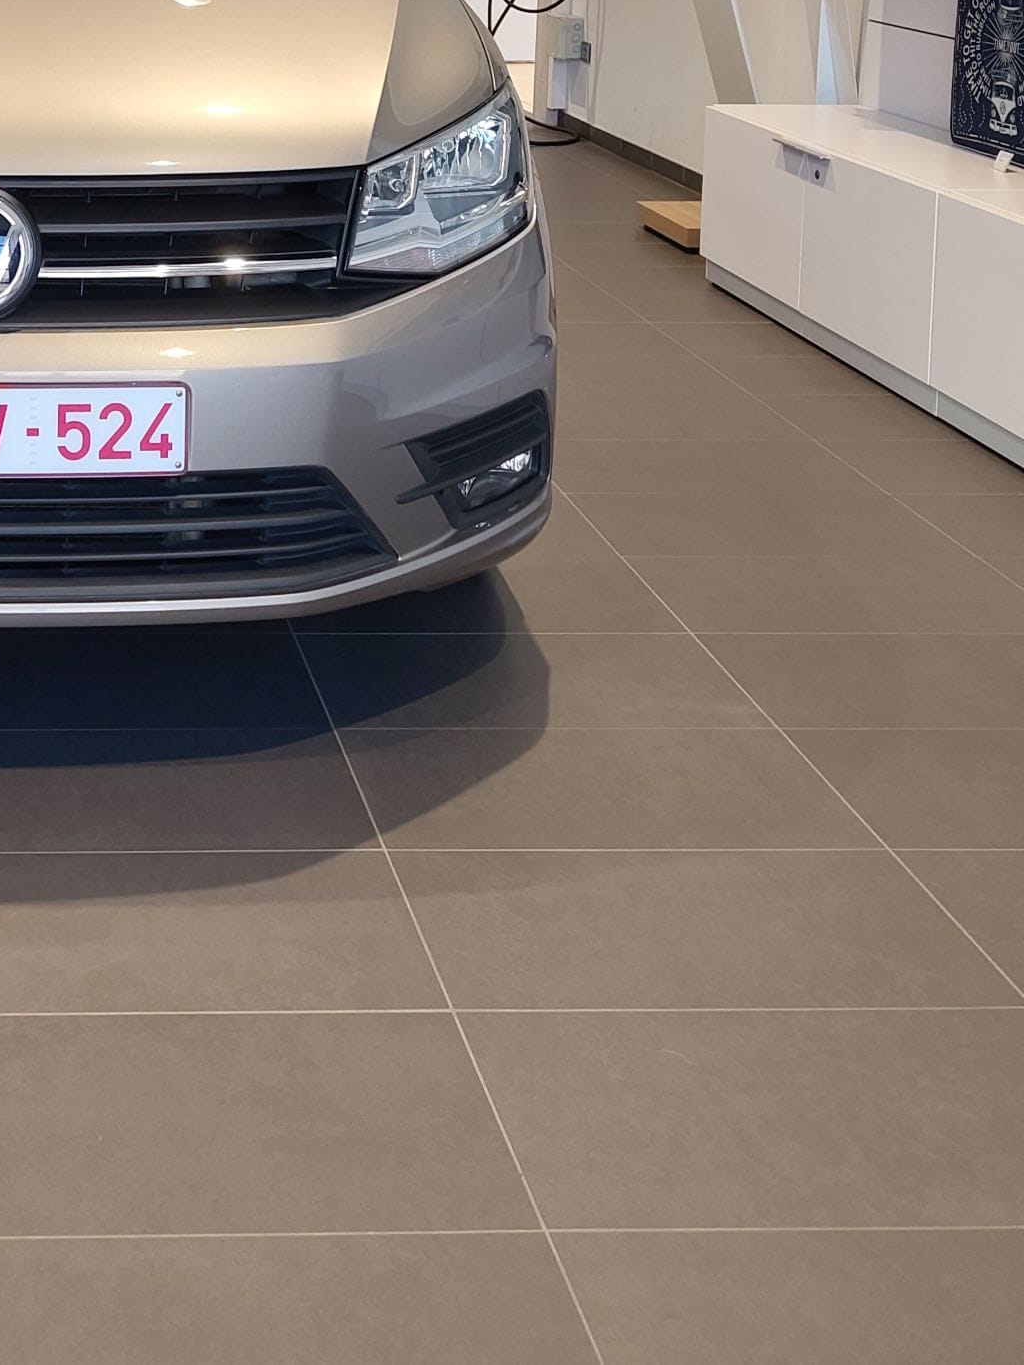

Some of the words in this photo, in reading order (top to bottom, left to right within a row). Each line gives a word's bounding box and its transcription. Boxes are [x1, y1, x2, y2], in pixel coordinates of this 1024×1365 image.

[987, 0, 996, 14] ON
[964, 9, 974, 40] GET
[971, 10, 982, 34] THE
[963, 45, 971, 66] TO
[971, 61, 979, 78] TO
[966, 67, 981, 104] TIME
